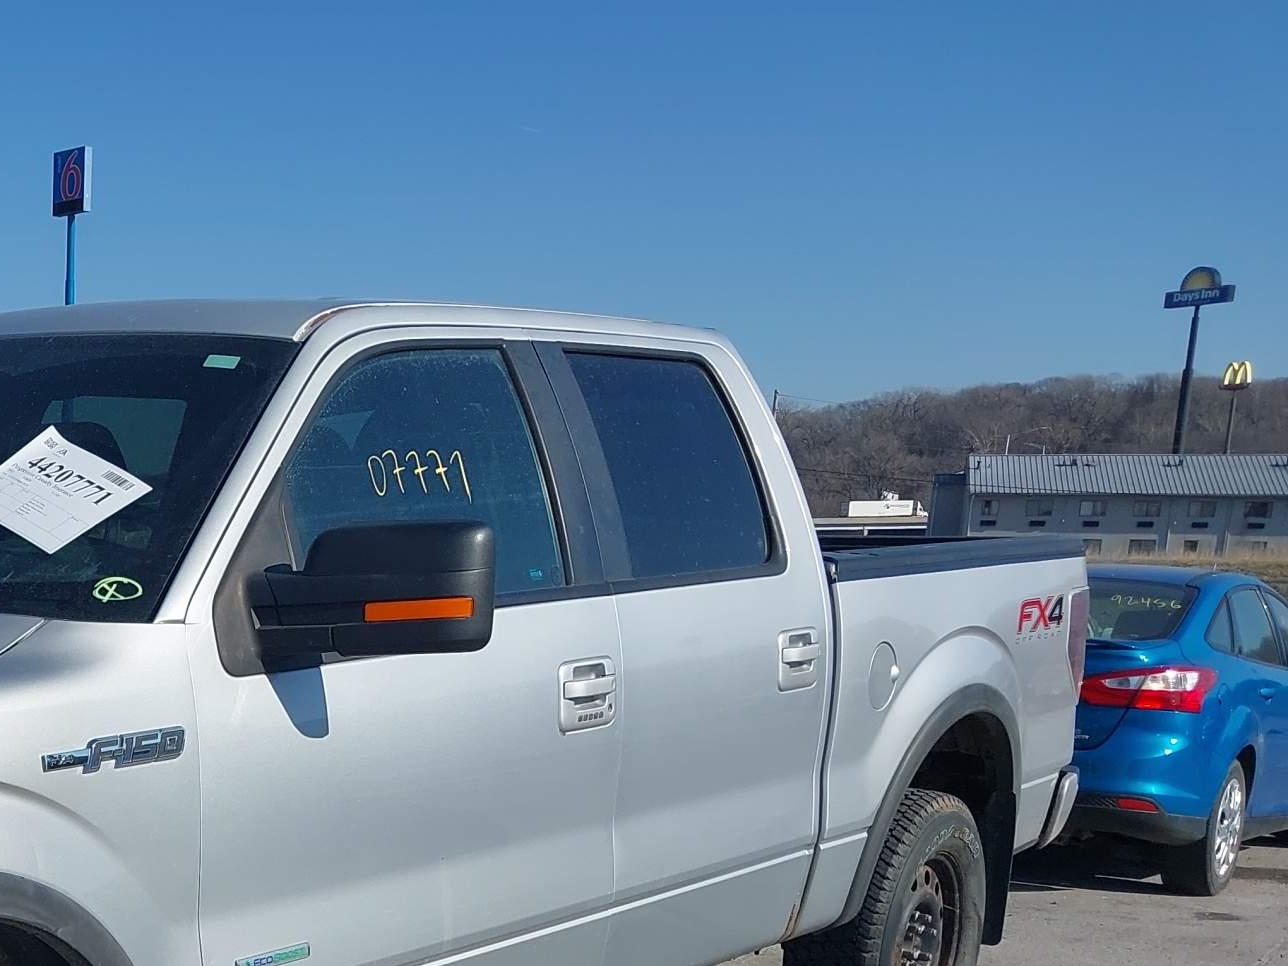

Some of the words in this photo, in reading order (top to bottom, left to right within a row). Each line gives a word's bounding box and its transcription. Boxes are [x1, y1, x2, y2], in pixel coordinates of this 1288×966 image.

[60, 150, 82, 201] 6
[1173, 291, 1199, 303] Days
[1201, 288, 1220, 299] Inn
[27, 456, 113, 506] 44207771
[367, 449, 472, 505] 07771
[1016, 594, 1065, 635] FX4
[1110, 593, 1183, 609] 92456
